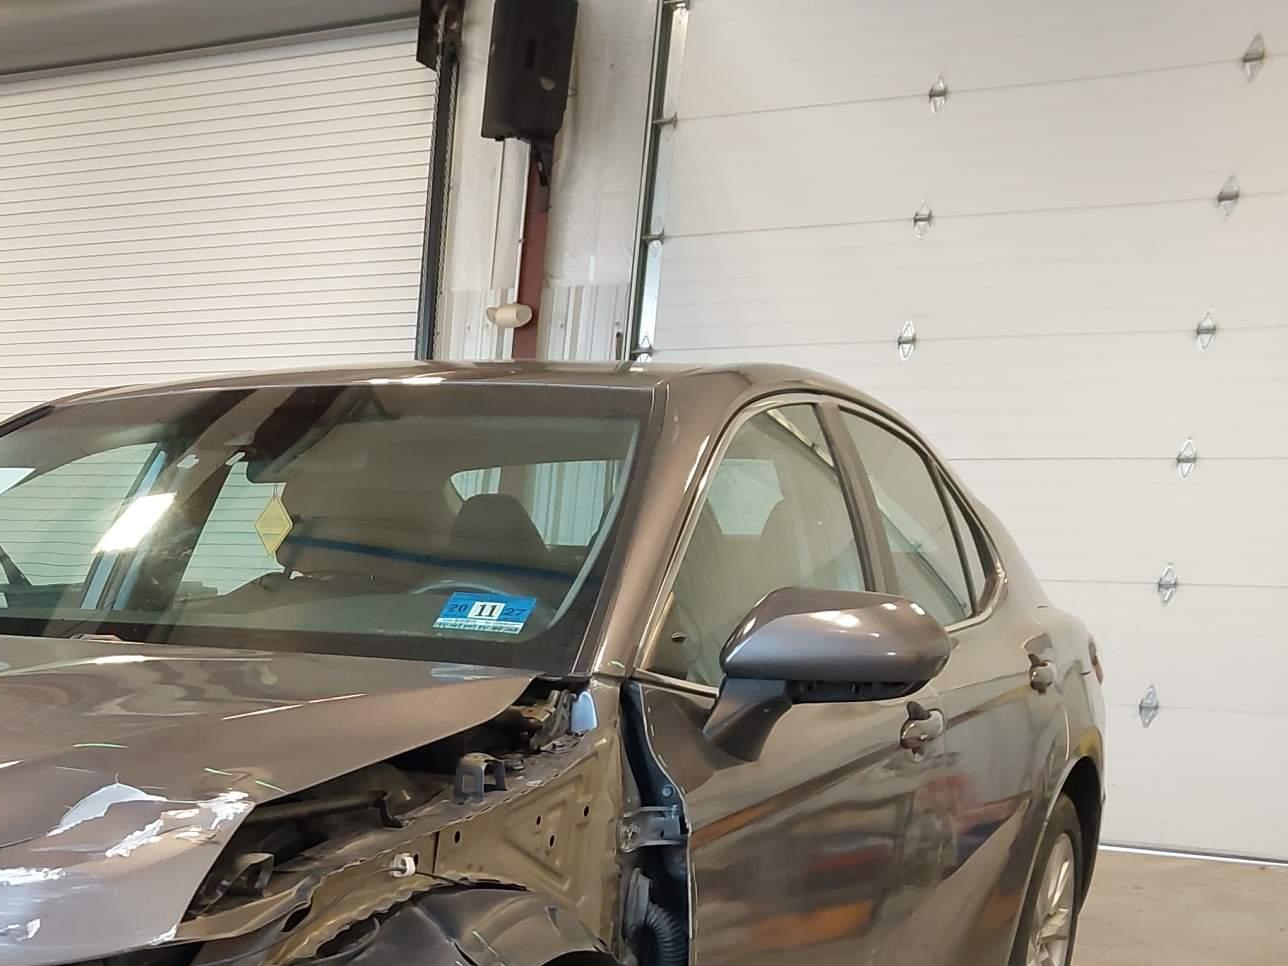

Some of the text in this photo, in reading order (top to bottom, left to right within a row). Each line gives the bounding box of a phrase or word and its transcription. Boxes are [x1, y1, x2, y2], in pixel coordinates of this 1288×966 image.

[448, 603, 527, 618] 20 11 27
